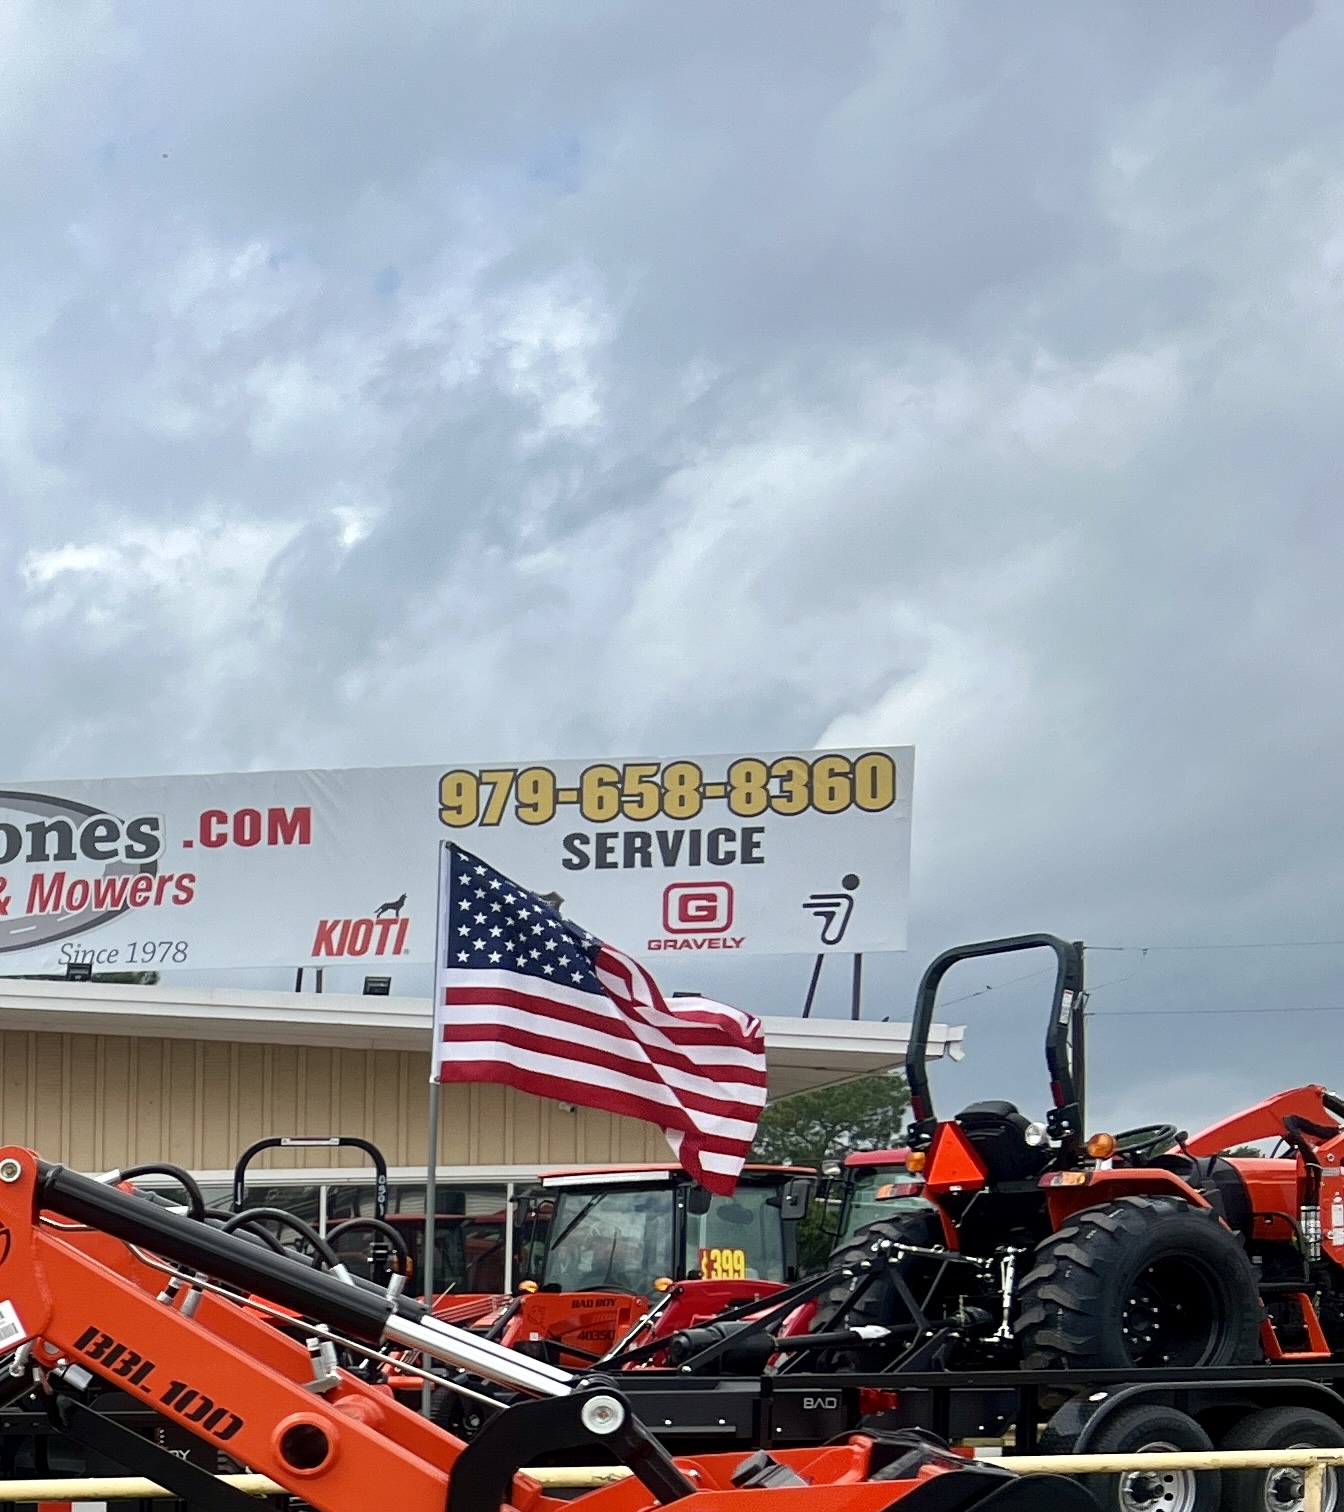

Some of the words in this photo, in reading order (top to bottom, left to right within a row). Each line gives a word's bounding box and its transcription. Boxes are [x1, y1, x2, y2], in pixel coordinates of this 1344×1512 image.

[437, 752, 896, 828] 979-658-8360
[182, 806, 312, 849] .COM
[562, 826, 766, 871] SERVICE
[25, 869, 197, 915] Mowers
[58, 941, 120, 966] Since
[124, 939, 189, 965] 1978
[312, 916, 410, 956] KIOTI
[646, 936, 745, 951] GRAVELY
[73, 1325, 156, 1394] BBL
[159, 1380, 245, 1441] 100
[803, 1397, 838, 1409] BAD
